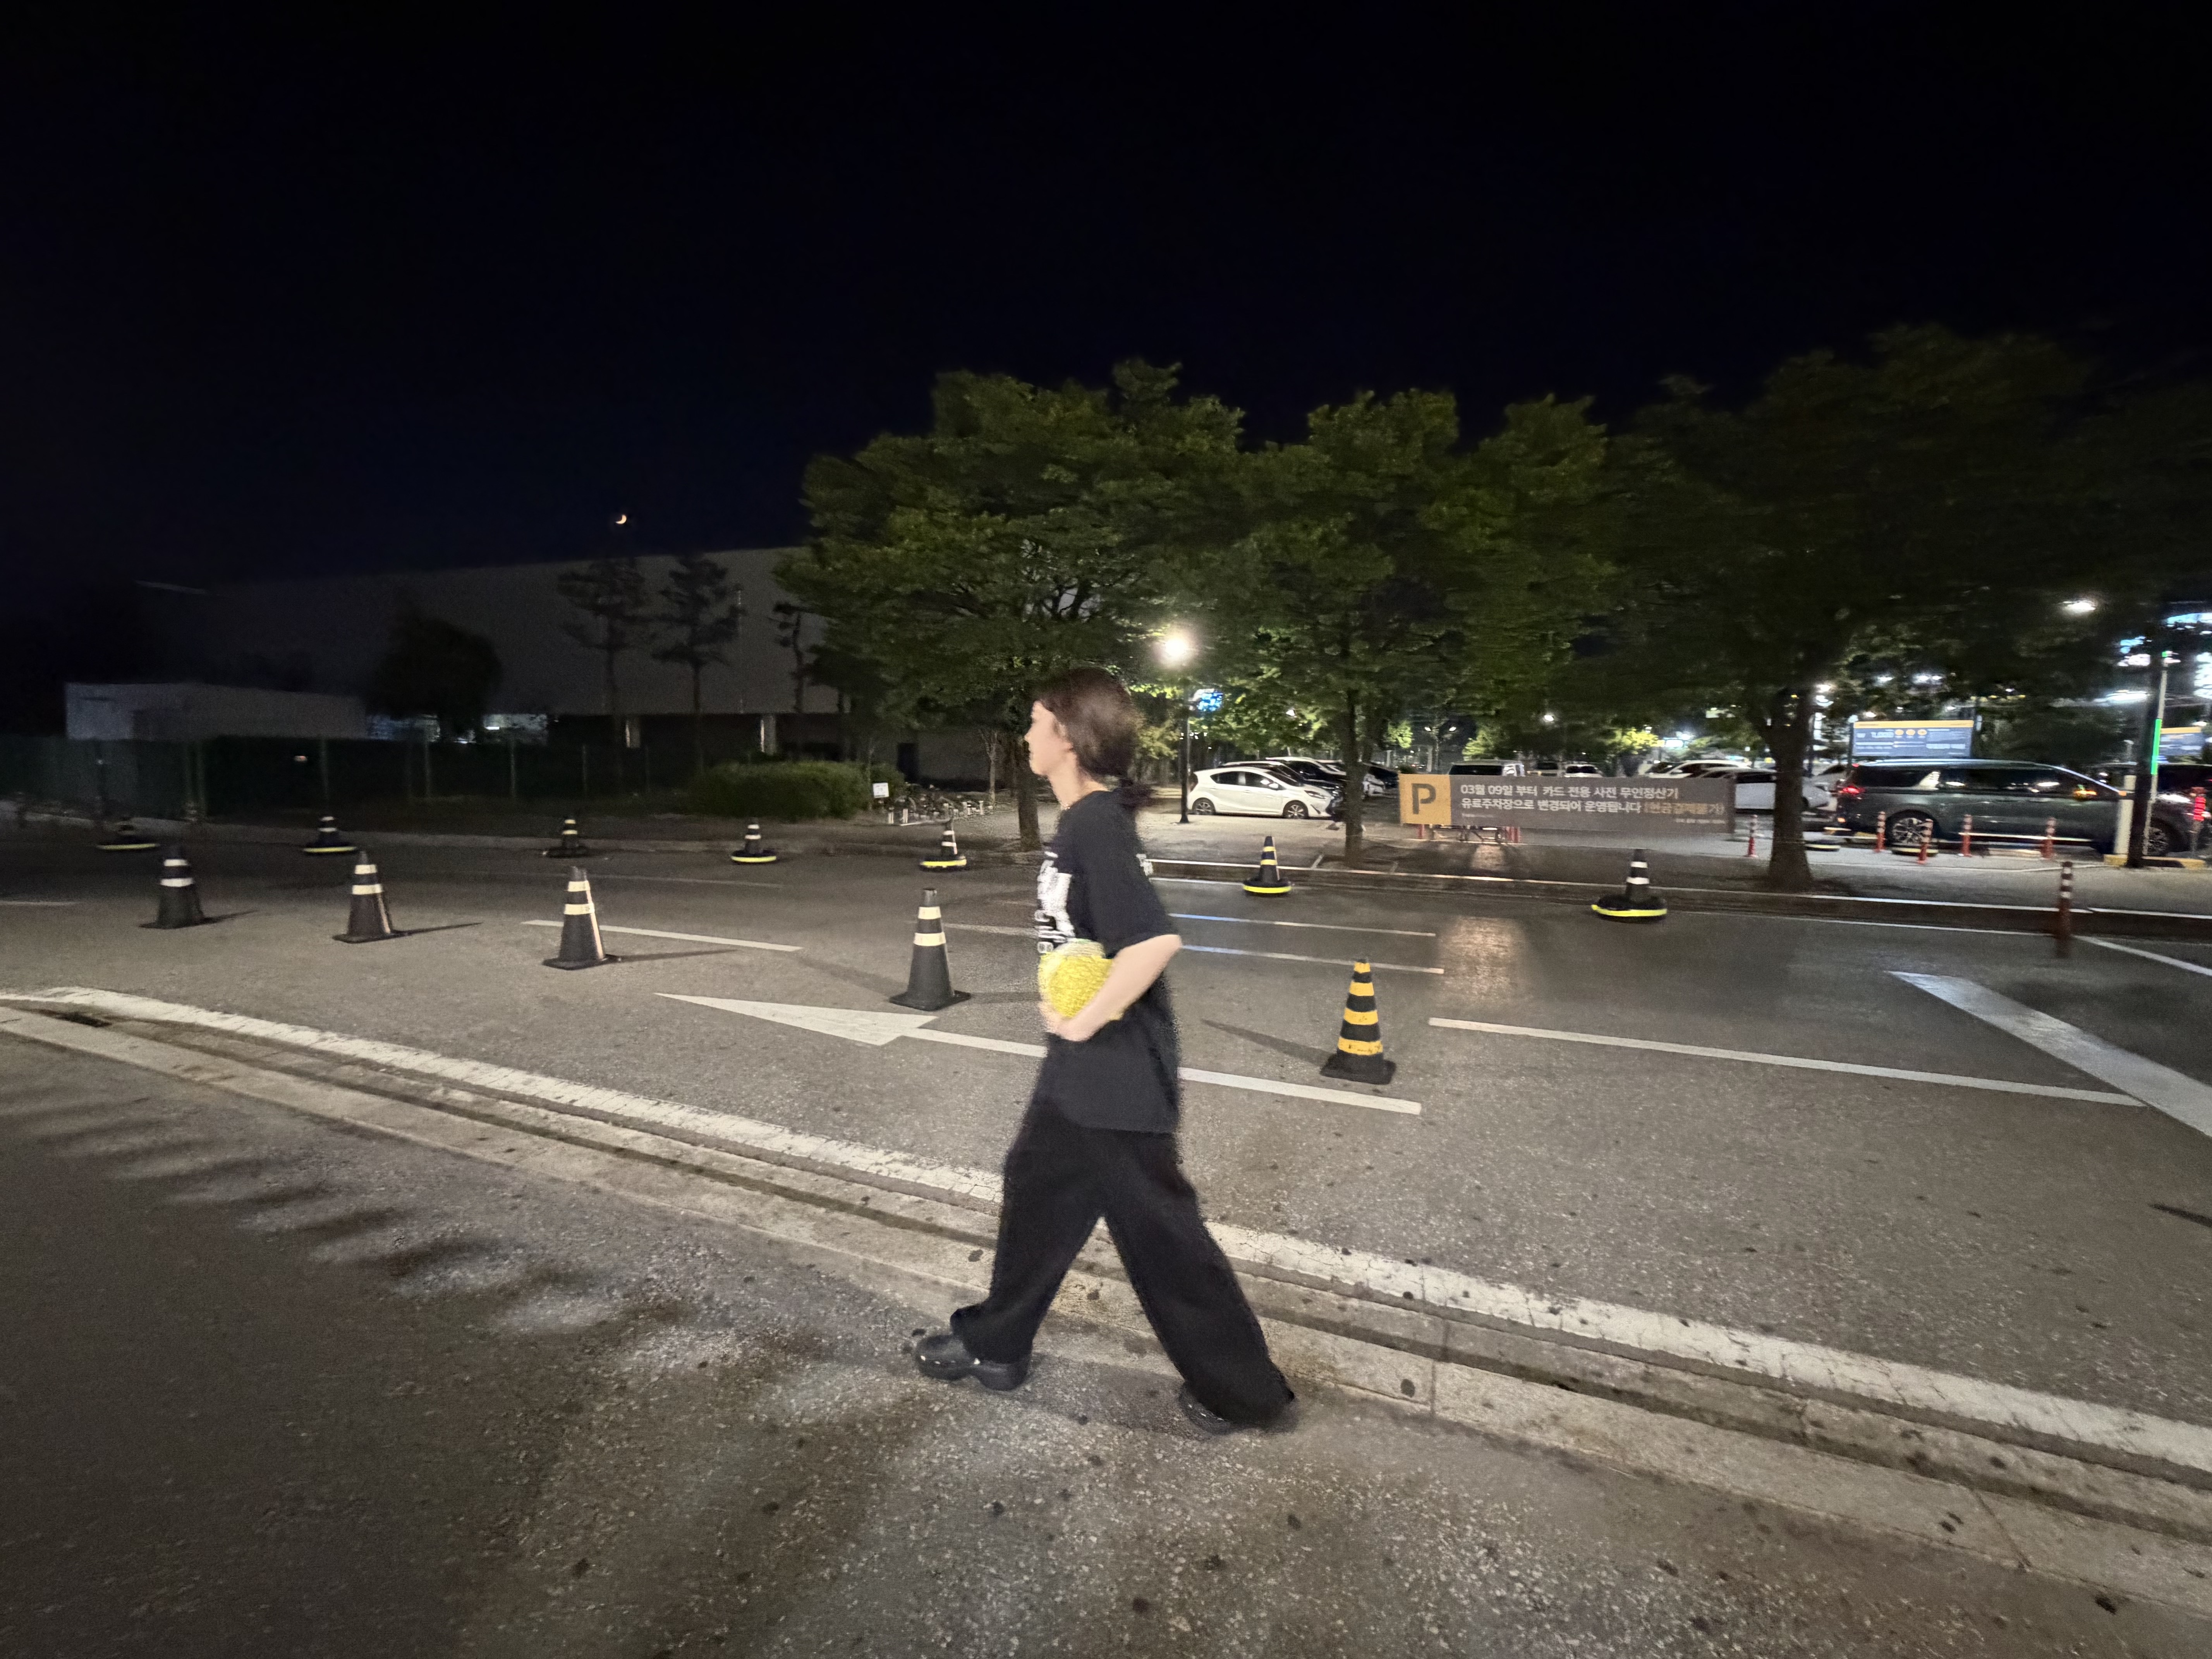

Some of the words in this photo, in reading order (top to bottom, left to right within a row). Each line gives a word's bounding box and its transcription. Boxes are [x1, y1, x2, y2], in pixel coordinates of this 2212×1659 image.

[1411, 783, 1436, 815] P
[1460, 784, 1485, 795] 03월
[1488, 785, 1513, 796] 09일
[1516, 785, 1537, 796] 부터
[1542, 786, 1566, 797] 카드
[1568, 786, 1591, 798] 전용
[1594, 787, 1617, 798] 사전
[1620, 787, 1678, 799] 무인정산기
[1461, 798, 1535, 810] 유료주차장으로
[1537, 800, 1582, 812] 변경되어
[1585, 800, 1642, 814] 운영됩니다
